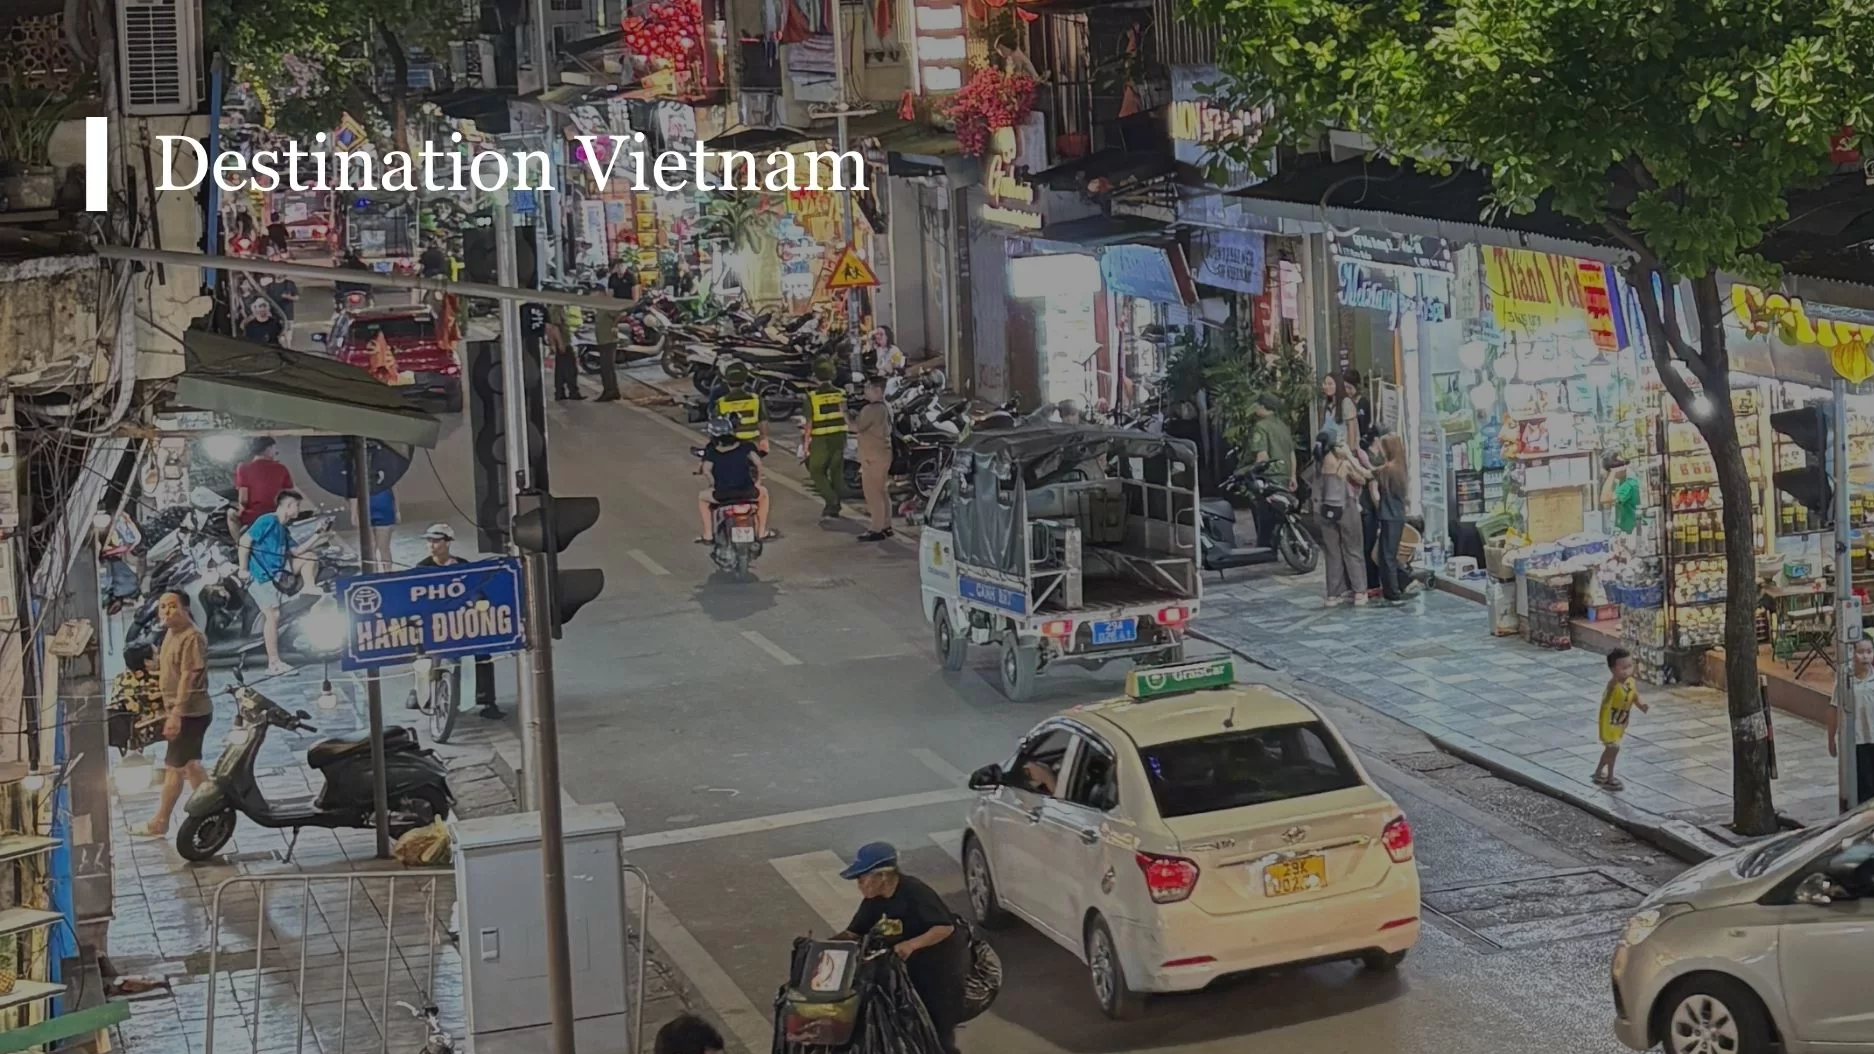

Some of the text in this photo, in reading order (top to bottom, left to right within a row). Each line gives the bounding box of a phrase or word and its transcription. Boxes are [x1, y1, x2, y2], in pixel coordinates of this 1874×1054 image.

[410, 574, 467, 602] PHỐ
[356, 600, 512, 651] HÀNG ĐƯỜNG
